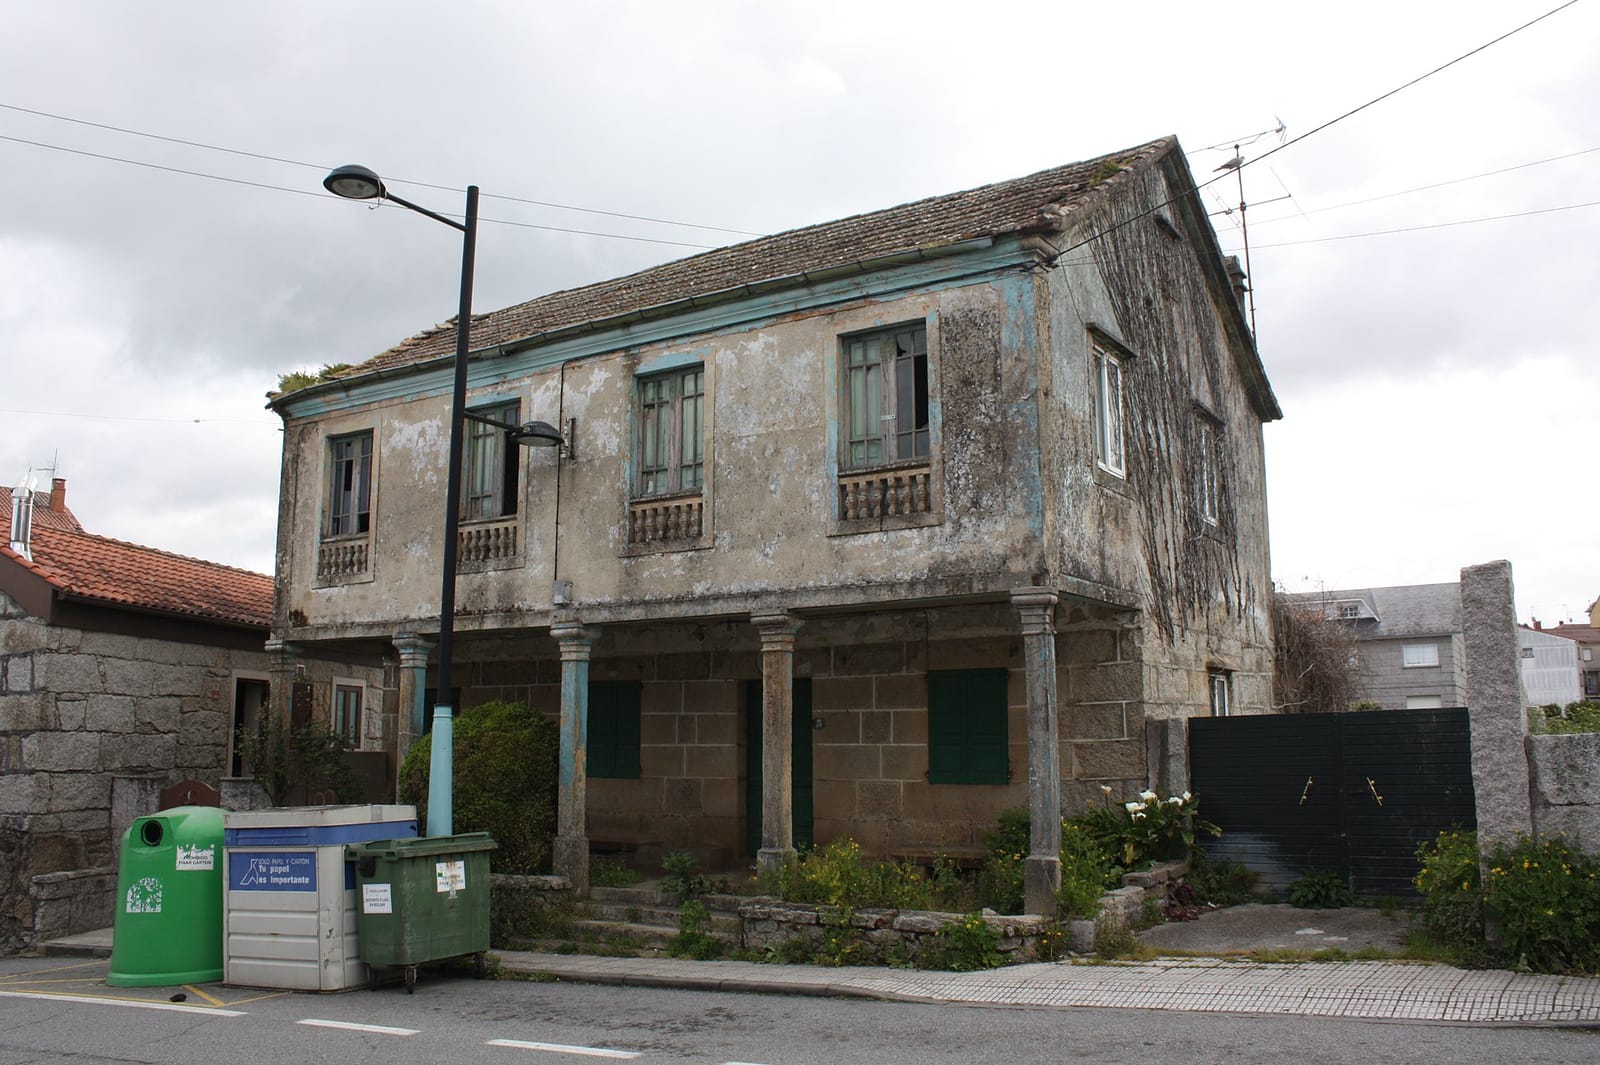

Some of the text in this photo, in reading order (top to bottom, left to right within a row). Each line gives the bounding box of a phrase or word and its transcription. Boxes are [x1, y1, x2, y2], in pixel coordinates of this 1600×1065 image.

[258, 864, 290, 874] Tu papel
[258, 875, 310, 886] es importante
